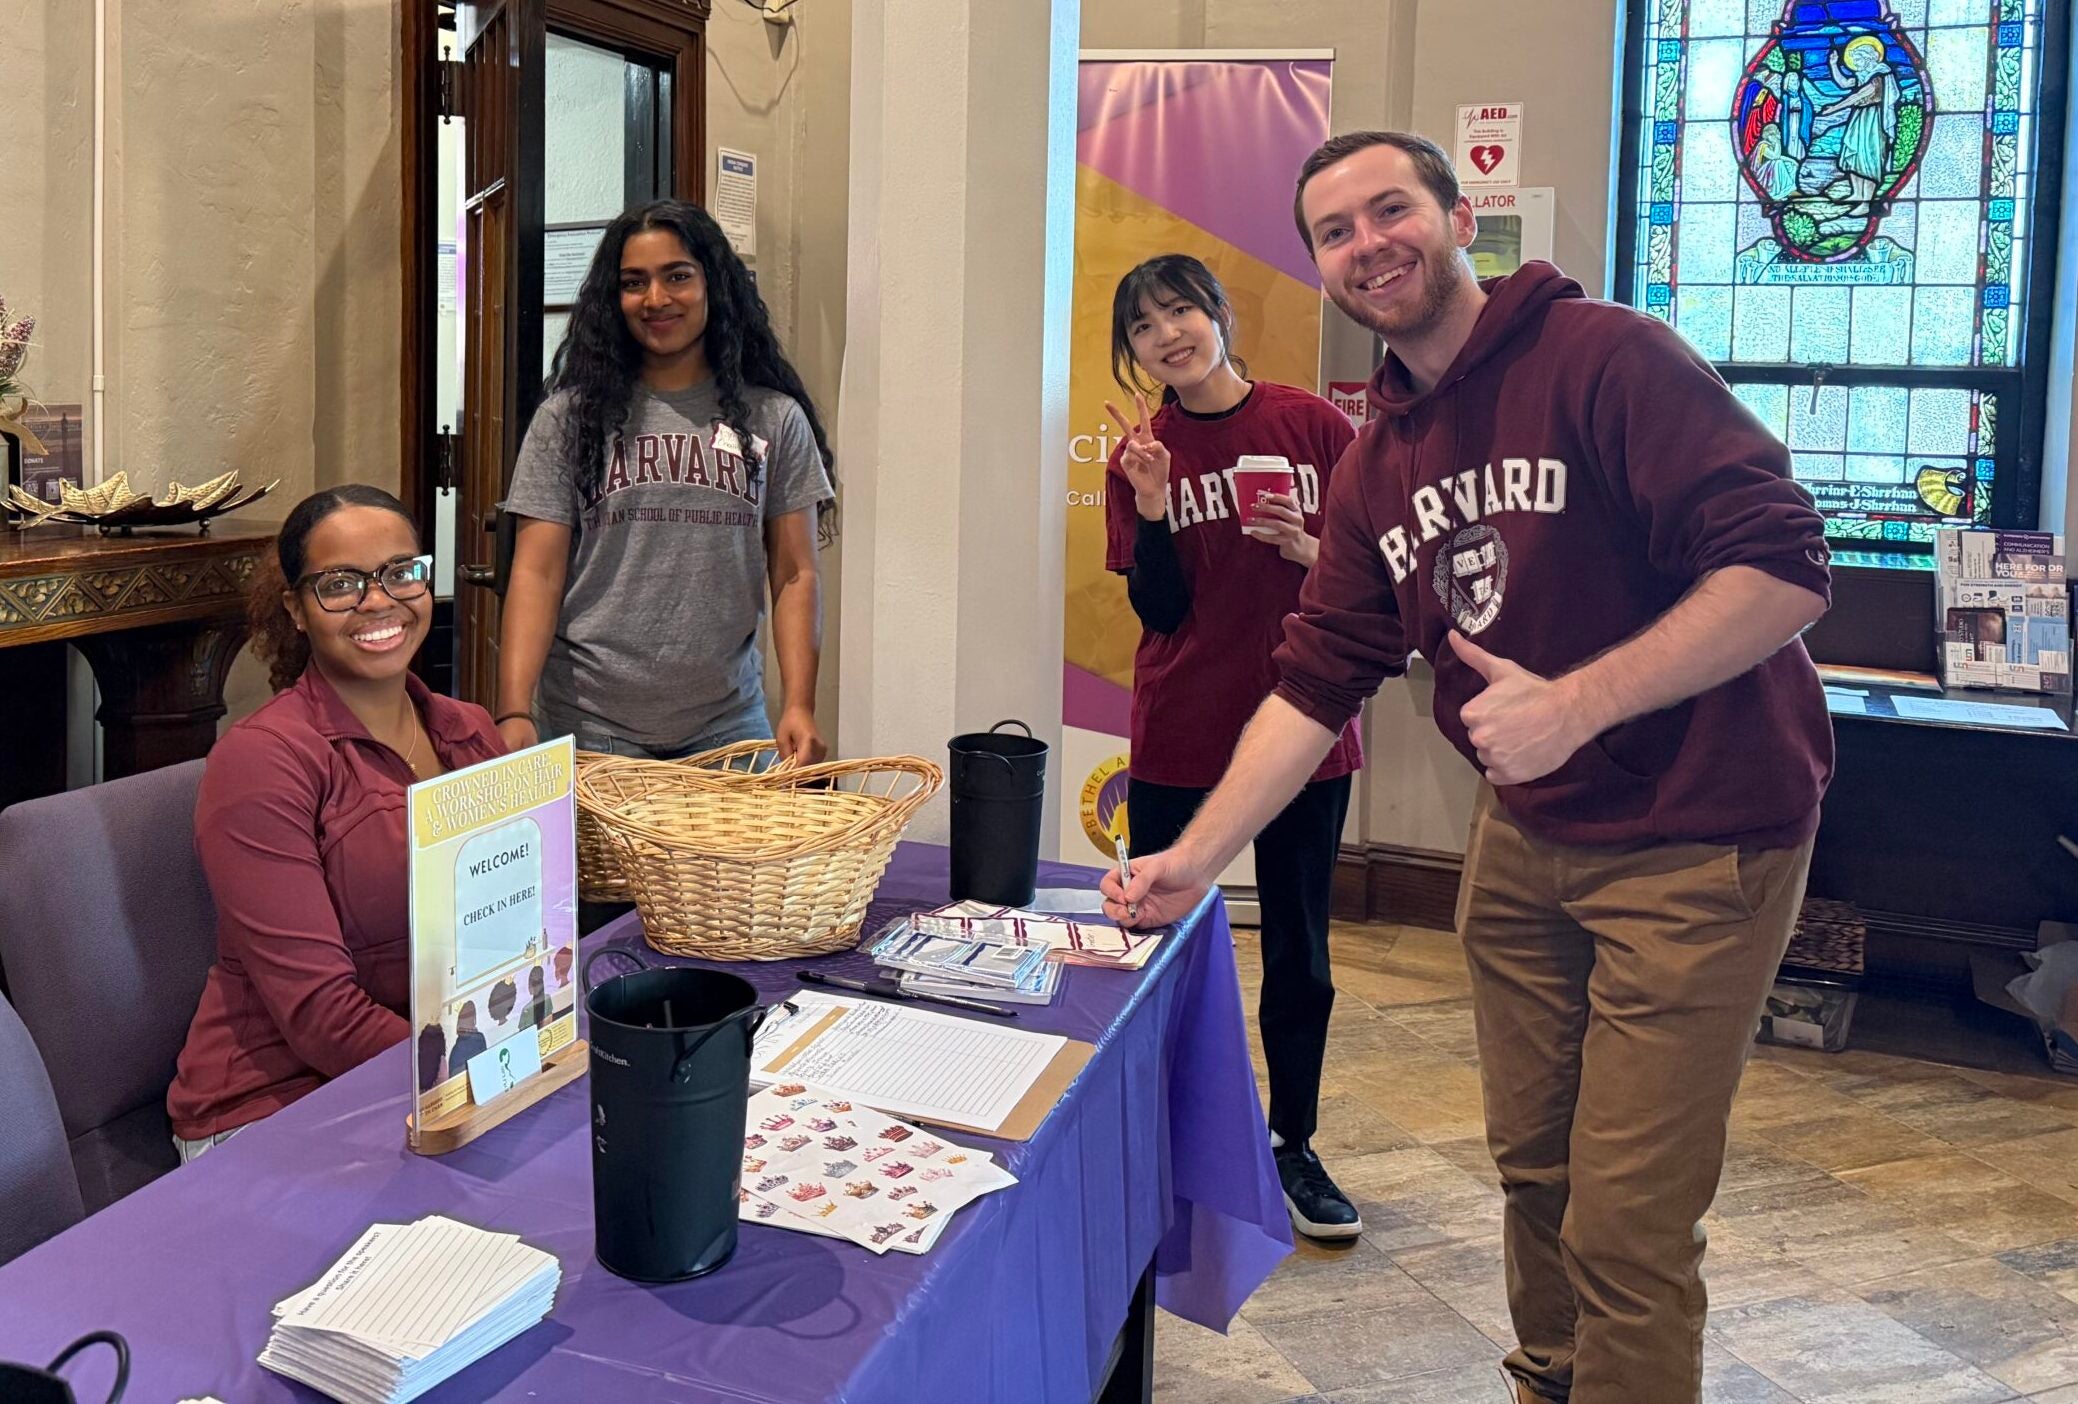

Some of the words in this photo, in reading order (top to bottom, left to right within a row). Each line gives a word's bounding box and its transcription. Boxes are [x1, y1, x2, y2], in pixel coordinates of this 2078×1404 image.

[1472, 195, 1516, 207] LATOR
[1334, 399, 1364, 416] FIRE
[1068, 423, 1122, 463] ci
[627, 508, 666, 522] SCHOOL
[669, 509, 682, 522] OF
[684, 509, 722, 525] PUBLIC
[1378, 457, 1568, 585] HRVARD
[1995, 562, 2023, 571] HERE
[2025, 564, 2046, 572] FOR
[425, 808, 435, 824] A
[437, 783, 510, 818] WORKSHOP
[513, 775, 531, 793] ON
[534, 763, 564, 785] HAIR
[432, 767, 499, 804] CROWNED
[502, 765, 515, 781] IN
[518, 753, 552, 773] CARE:
[1081, 767, 1110, 829] BETHEL
[432, 820, 443, 837] &
[445, 799, 508, 833] WOMEN'S
[510, 780, 557, 807] HEALTH
[469, 842, 530, 878] WELCOME!
[463, 903, 496, 927] CHECK
[497, 896, 509, 913] IN
[509, 885, 536, 907] HERE!
[297, 1300, 316, 1316] Have
[317, 1273, 340, 1297] question
[338, 1265, 348, 1276] for
[346, 1256, 357, 1266] the
[355, 1231, 381, 1257] speakers?
[335, 1275, 354, 1291] Share
